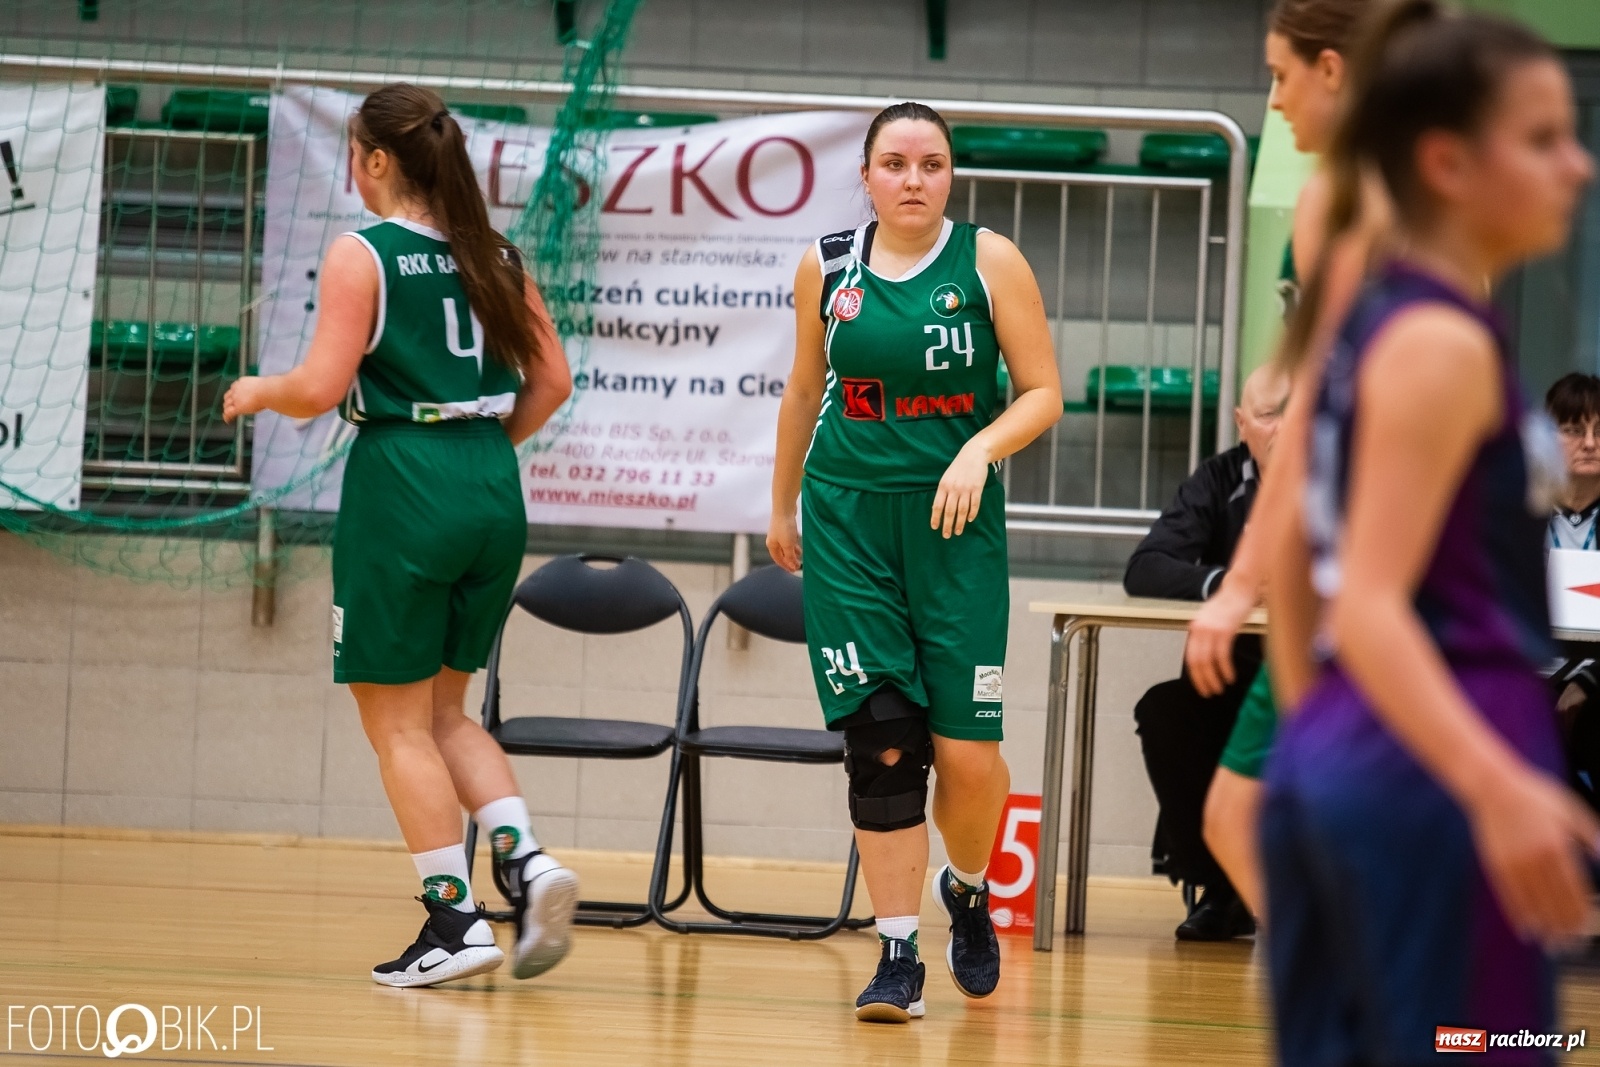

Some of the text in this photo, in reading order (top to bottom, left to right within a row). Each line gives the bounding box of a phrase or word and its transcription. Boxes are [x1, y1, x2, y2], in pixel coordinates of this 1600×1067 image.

[397, 253, 433, 276] RKK
[626, 249, 651, 264] na
[655, 284, 796, 309] cukiernic
[443, 298, 485, 377] 4
[552, 316, 720, 346] odukcyjny
[924, 322, 974, 370] 24
[574, 368, 790, 398] ekamy na Cie
[895, 392, 975, 417] KAMAN
[530, 463, 716, 487] tel. 032 796 11 33
[530, 487, 697, 511] www.mieszko.pl
[821, 642, 868, 696] 24
[988, 808, 1041, 898] 5
